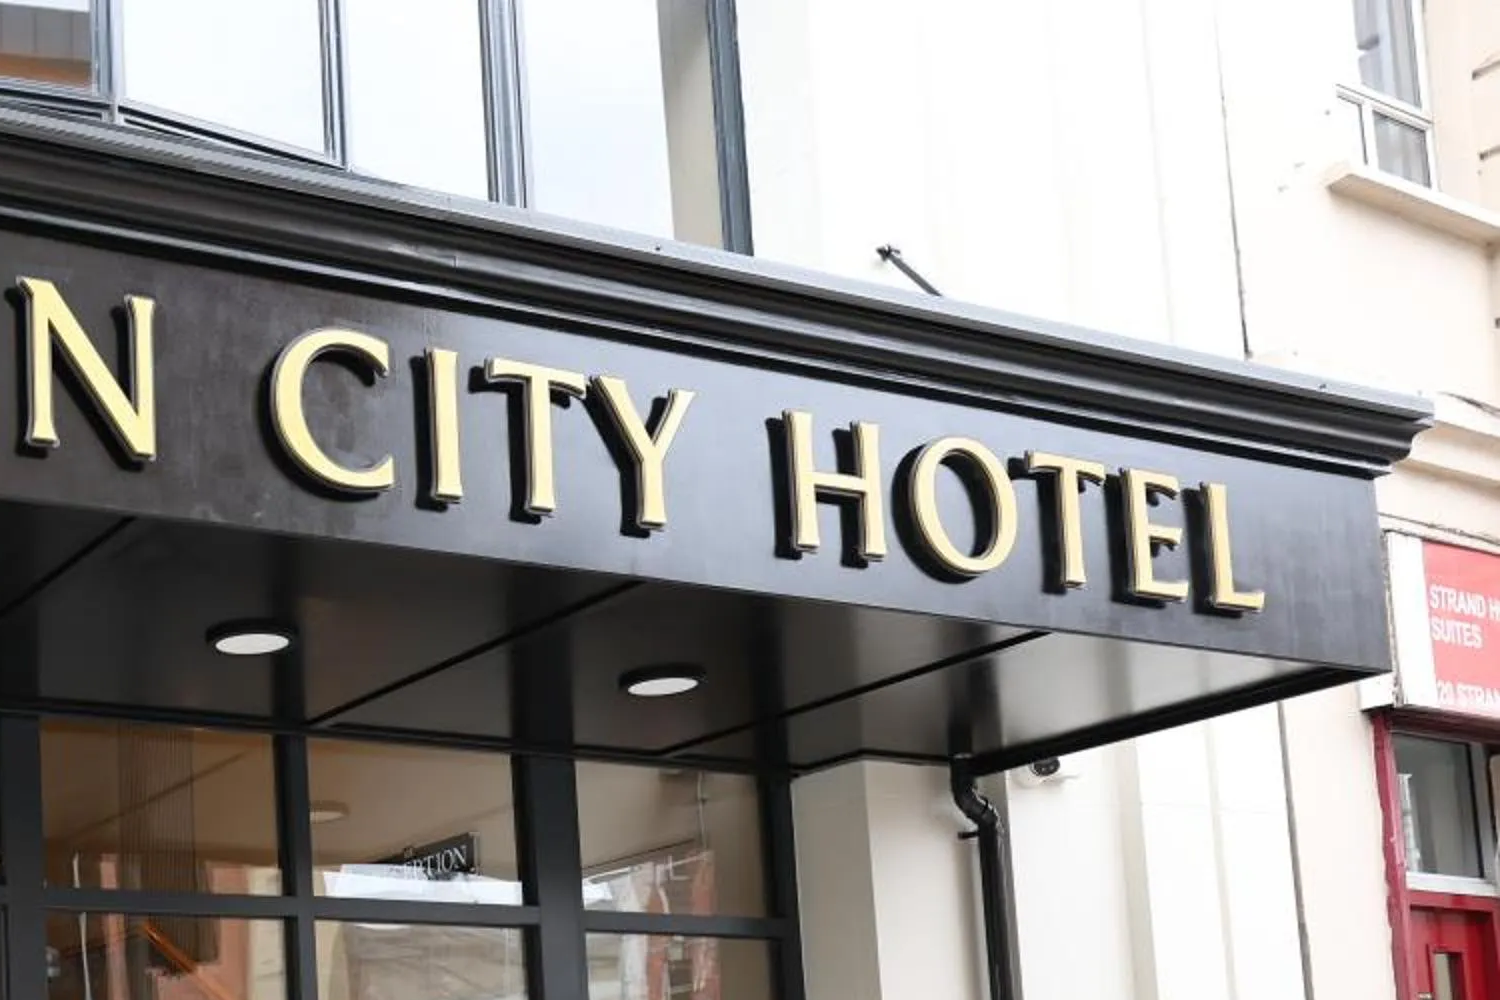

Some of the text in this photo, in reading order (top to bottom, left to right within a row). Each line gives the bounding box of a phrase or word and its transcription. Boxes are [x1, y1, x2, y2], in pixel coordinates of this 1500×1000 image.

[263, 326, 695, 534] CITY
[778, 408, 1266, 617] HOTEL
[1429, 584, 1486, 616] STRAND
[1431, 615, 1483, 649] SUITES
